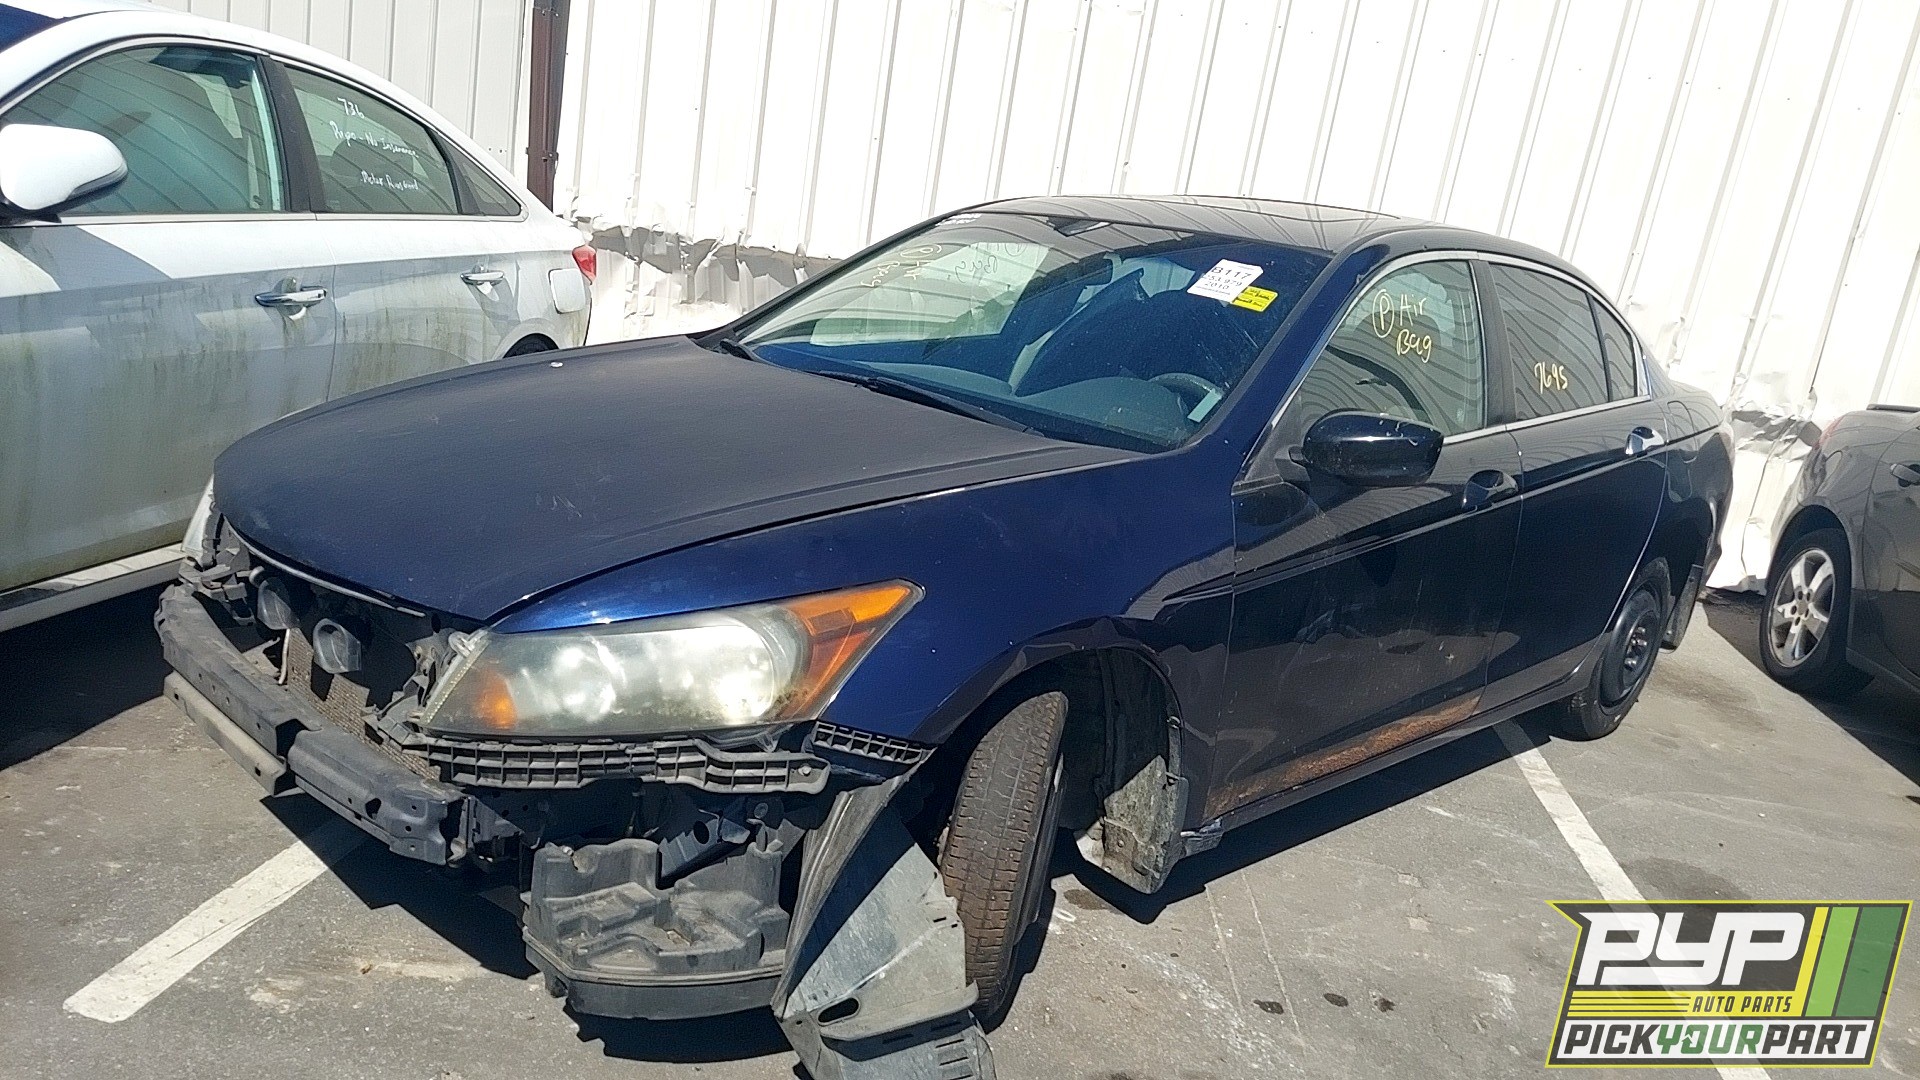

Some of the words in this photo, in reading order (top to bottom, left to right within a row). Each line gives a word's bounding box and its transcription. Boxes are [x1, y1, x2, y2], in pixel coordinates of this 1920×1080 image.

[1211, 266, 1252, 280] B117
[1400, 293, 1427, 327] Air
[1396, 328, 1432, 364] Bag
